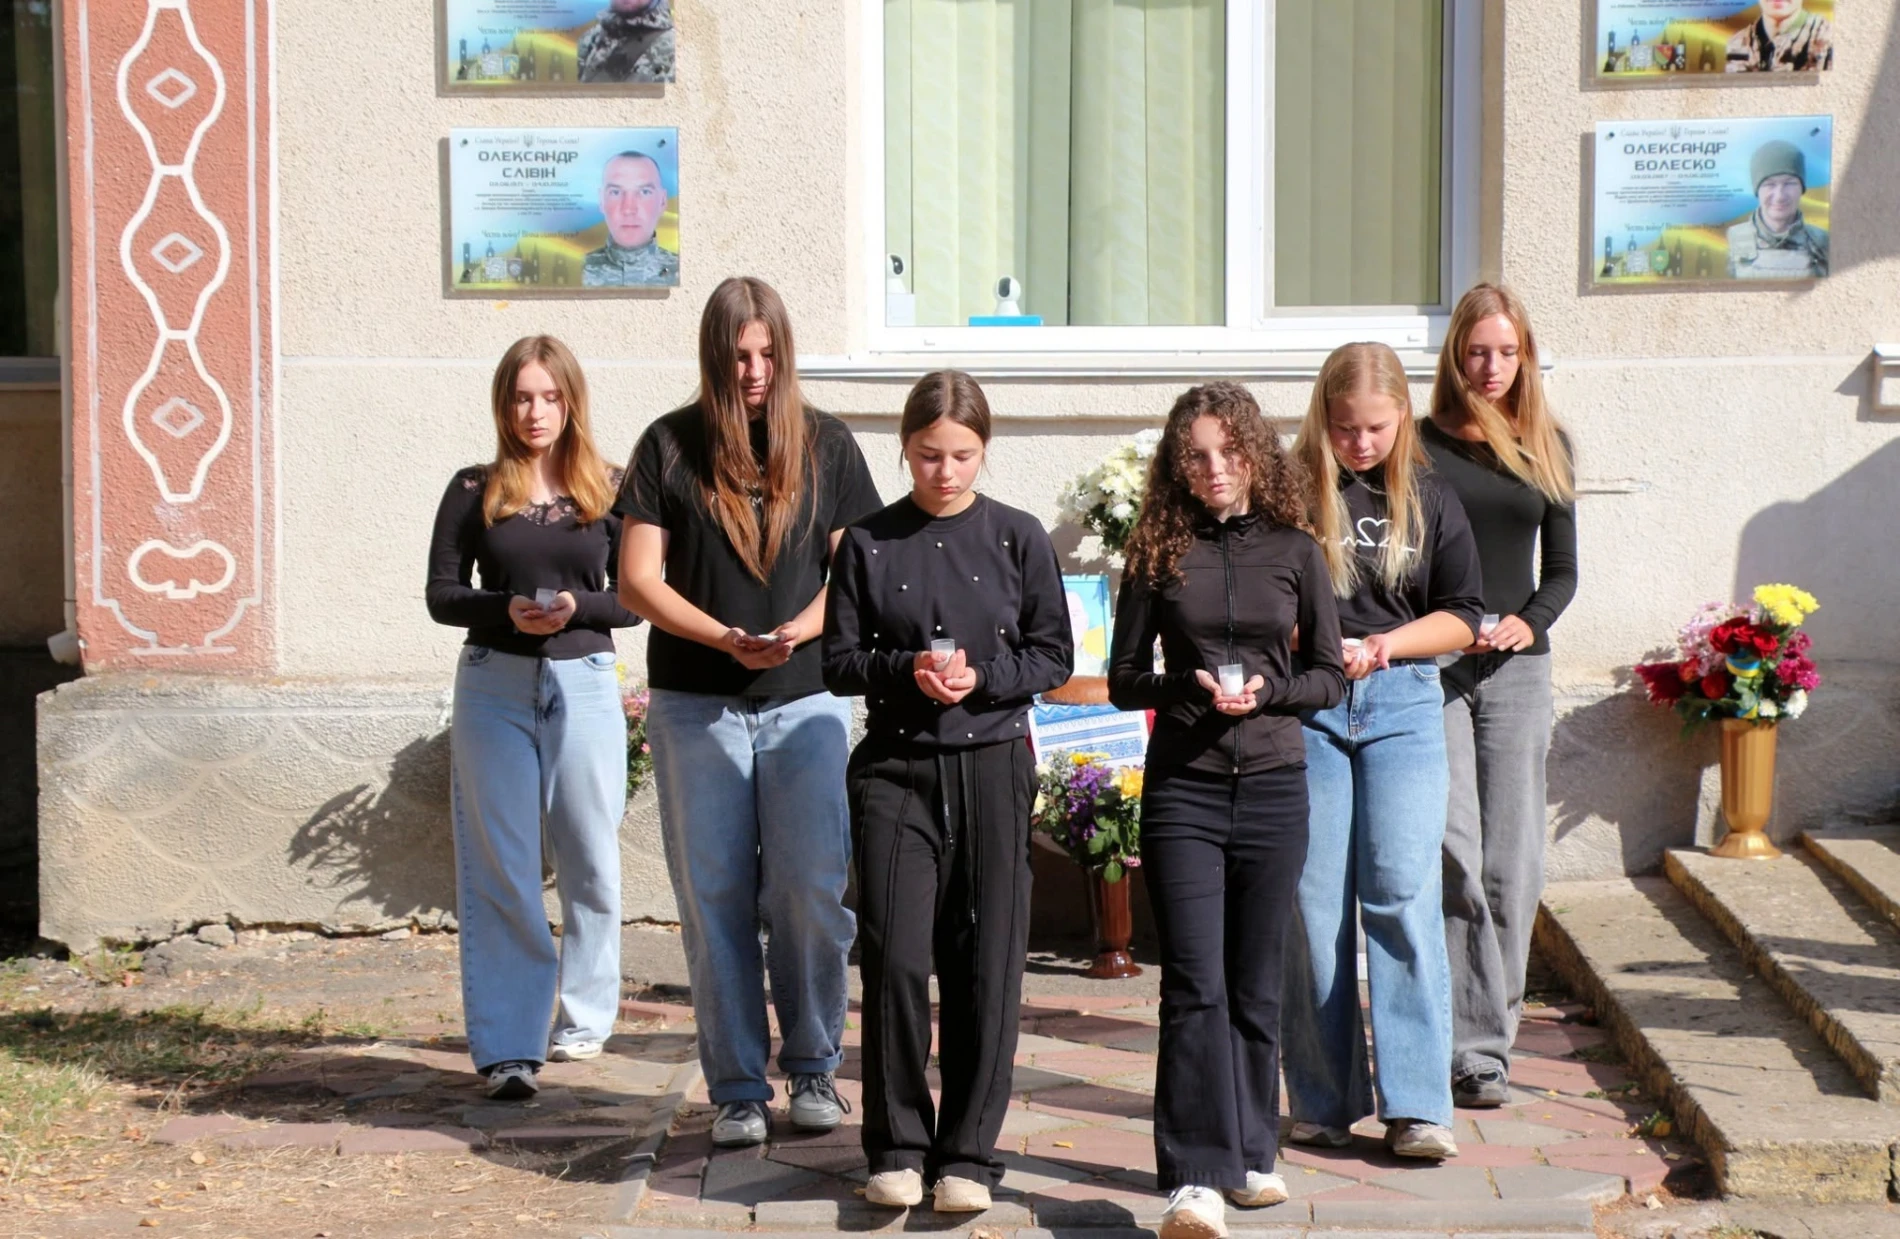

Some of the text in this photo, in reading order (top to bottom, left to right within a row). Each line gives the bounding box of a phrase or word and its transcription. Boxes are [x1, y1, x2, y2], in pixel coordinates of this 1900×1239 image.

[1623, 141, 1728, 156] ОЛЕКСАНДР
[478, 149, 579, 164] ОЛЕКСАНДР
[1634, 158, 1716, 171] БОЛЕСКО
[502, 166, 556, 179] СЛІВІН
